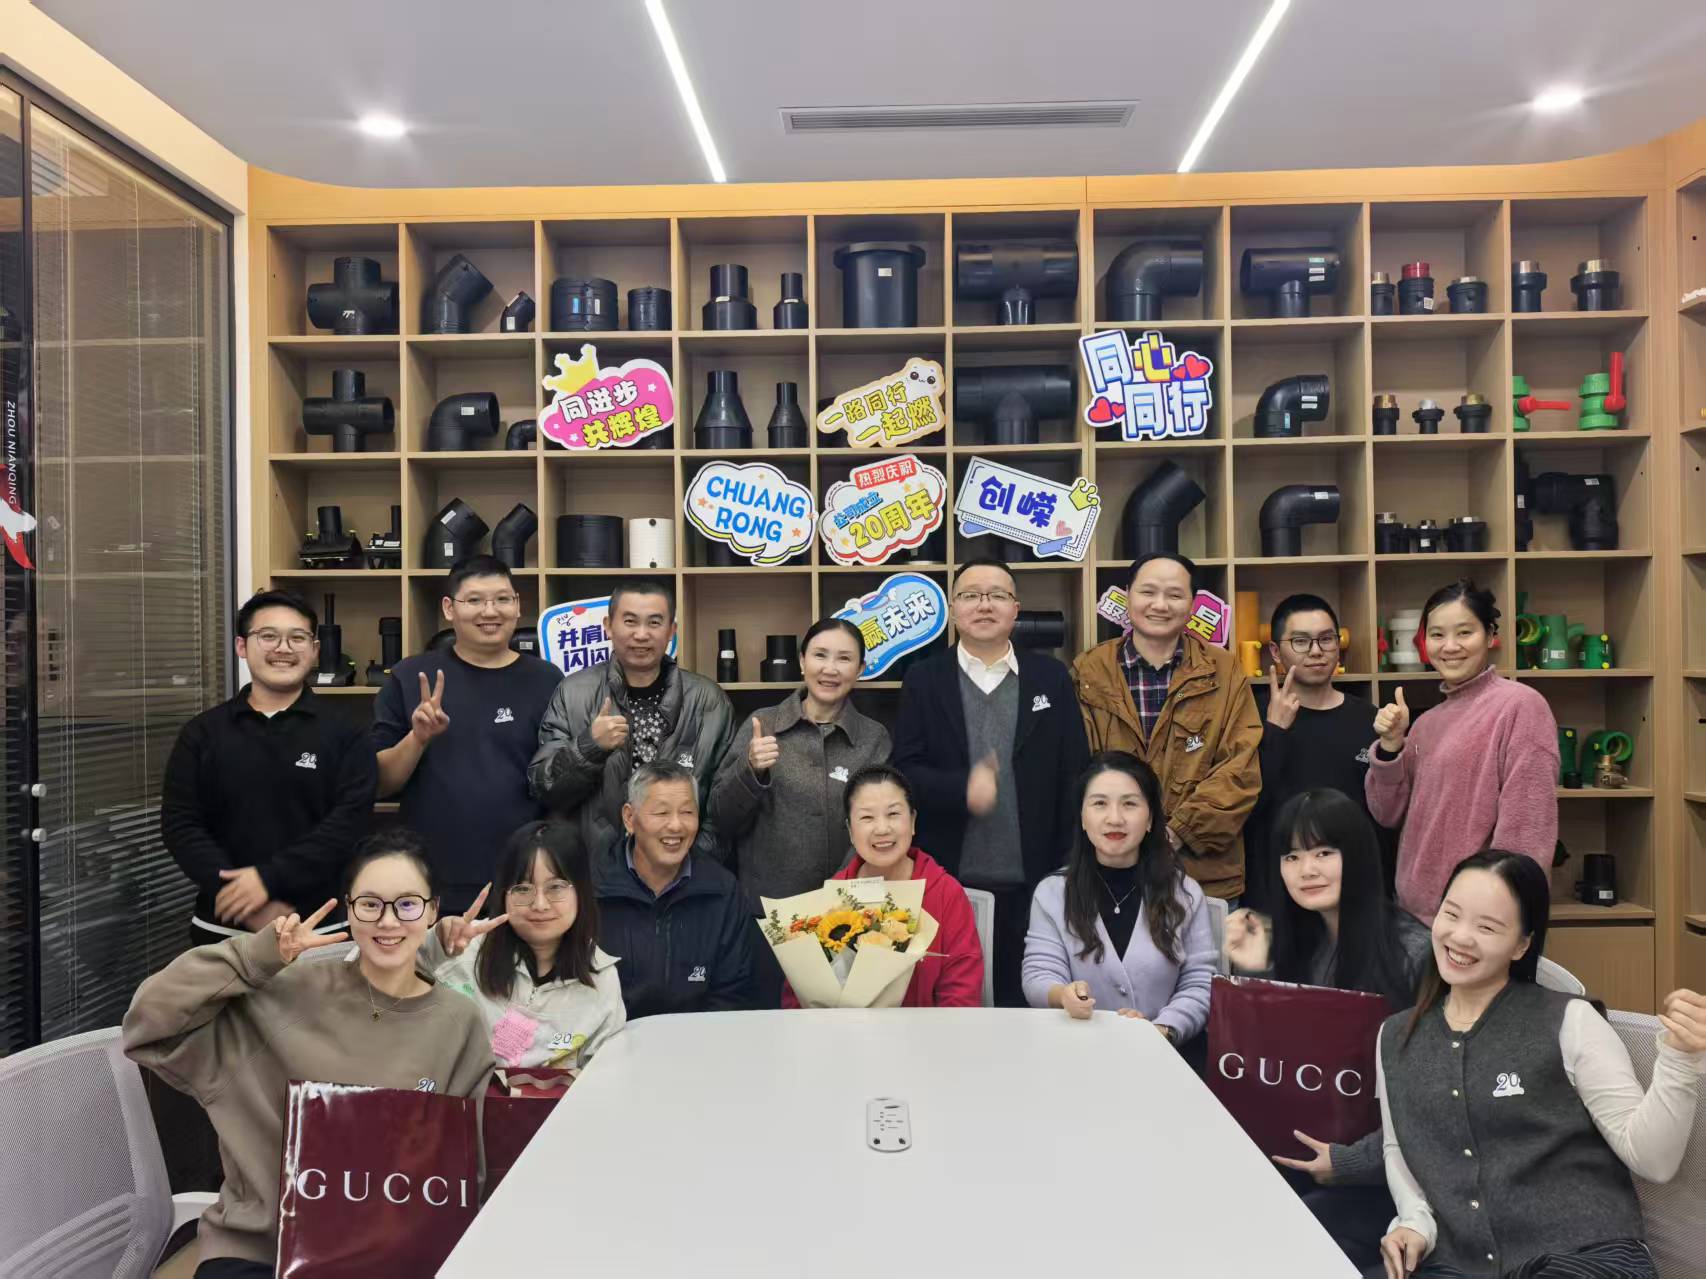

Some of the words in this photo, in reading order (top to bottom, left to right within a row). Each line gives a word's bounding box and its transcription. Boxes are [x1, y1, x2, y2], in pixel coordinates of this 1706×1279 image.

[1082, 330, 1173, 393] 同心
[7, 400, 16, 439] ZHOU
[558, 380, 639, 424] 同进步
[825, 381, 907, 424] 一路同行
[856, 396, 937, 440] 一起燃
[1122, 378, 1209, 438] 同行
[582, 404, 663, 447] 共辉煌
[7, 441, 17, 504] NIANQING
[858, 460, 914, 487] 热烈庆祝
[706, 475, 806, 519] CHUANG
[849, 488, 934, 549] 20周年
[979, 475, 1058, 528] 创嵘
[715, 507, 782, 543] RONG
[558, 625, 611, 650] 并肩
[1496, 1072, 1519, 1091] 20
[296, 1168, 468, 1207] GUCCI
